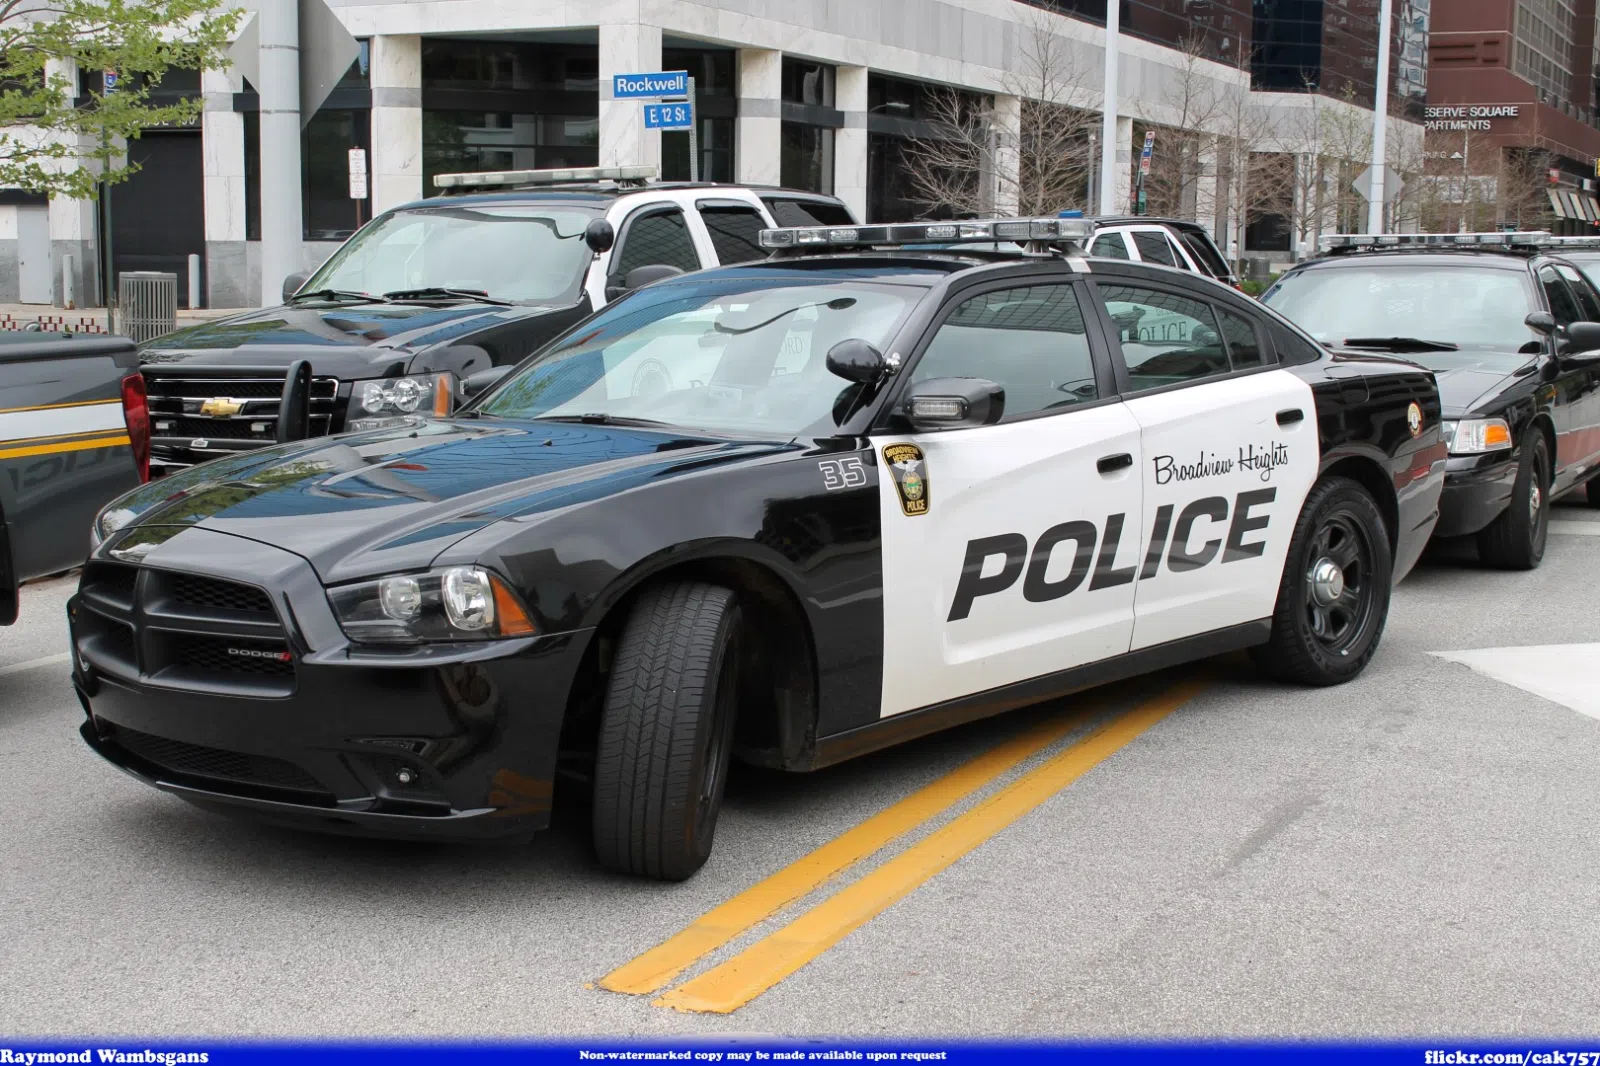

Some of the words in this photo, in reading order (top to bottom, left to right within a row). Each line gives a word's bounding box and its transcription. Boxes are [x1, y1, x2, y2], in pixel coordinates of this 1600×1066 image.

[617, 76, 684, 92] Rockwell
[650, 108, 659, 123] E.
[662, 108, 672, 122] 12
[675, 107, 686, 121] St
[1469, 106, 1518, 117] SQUARE
[885, 446, 919, 458] BROADVIEW
[893, 454, 916, 463] HEIGHTS
[1153, 451, 1234, 484] Broadview
[1238, 441, 1288, 482] Heights
[818, 457, 867, 490] 35
[907, 499, 925, 512] POLICE
[947, 486, 1277, 623] POLICE
[228, 648, 284, 659] DODGE
